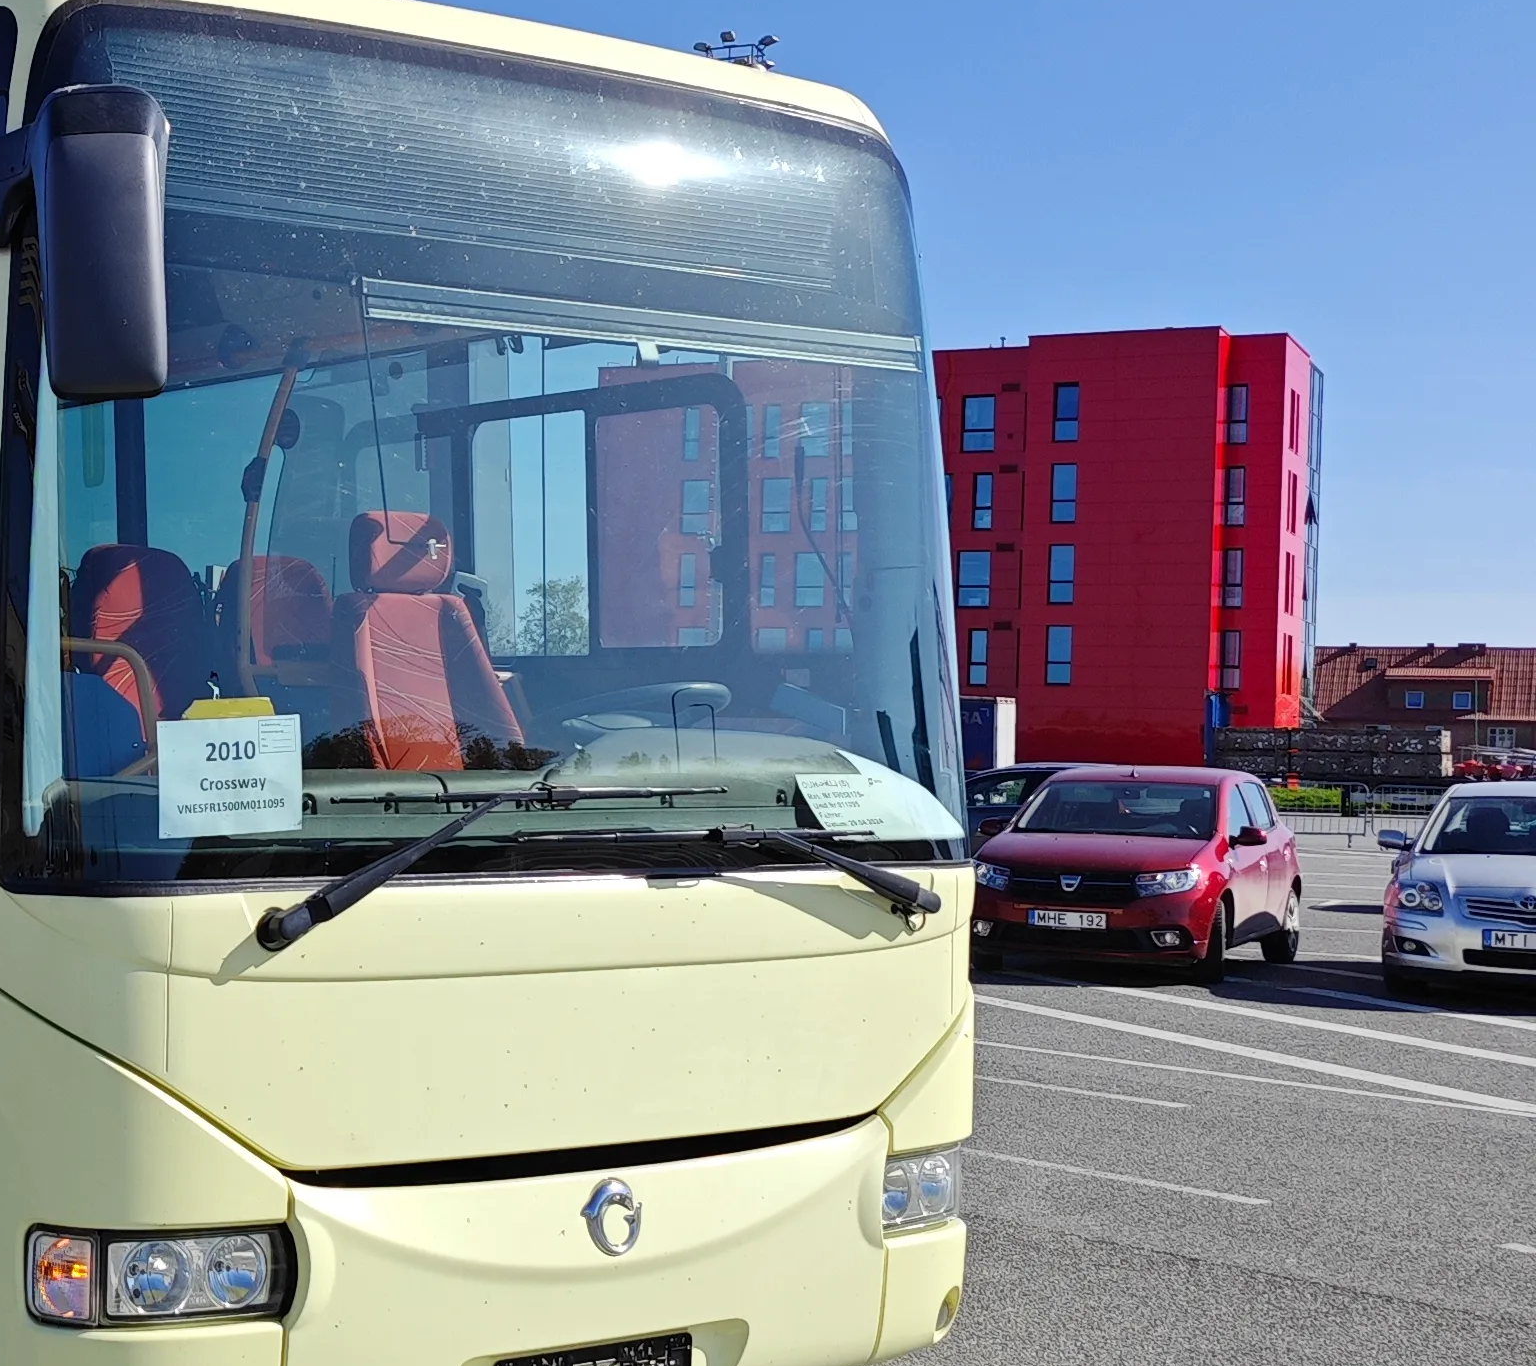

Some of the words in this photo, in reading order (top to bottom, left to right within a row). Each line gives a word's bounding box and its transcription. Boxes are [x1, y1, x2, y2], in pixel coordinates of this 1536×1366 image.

[205, 740, 256, 762] 2010
[199, 776, 267, 792] Crossway
[177, 798, 285, 815] VNESFR1500M011095
[1037, 911, 1067, 926] MHE
[1078, 914, 1104, 928] 192
